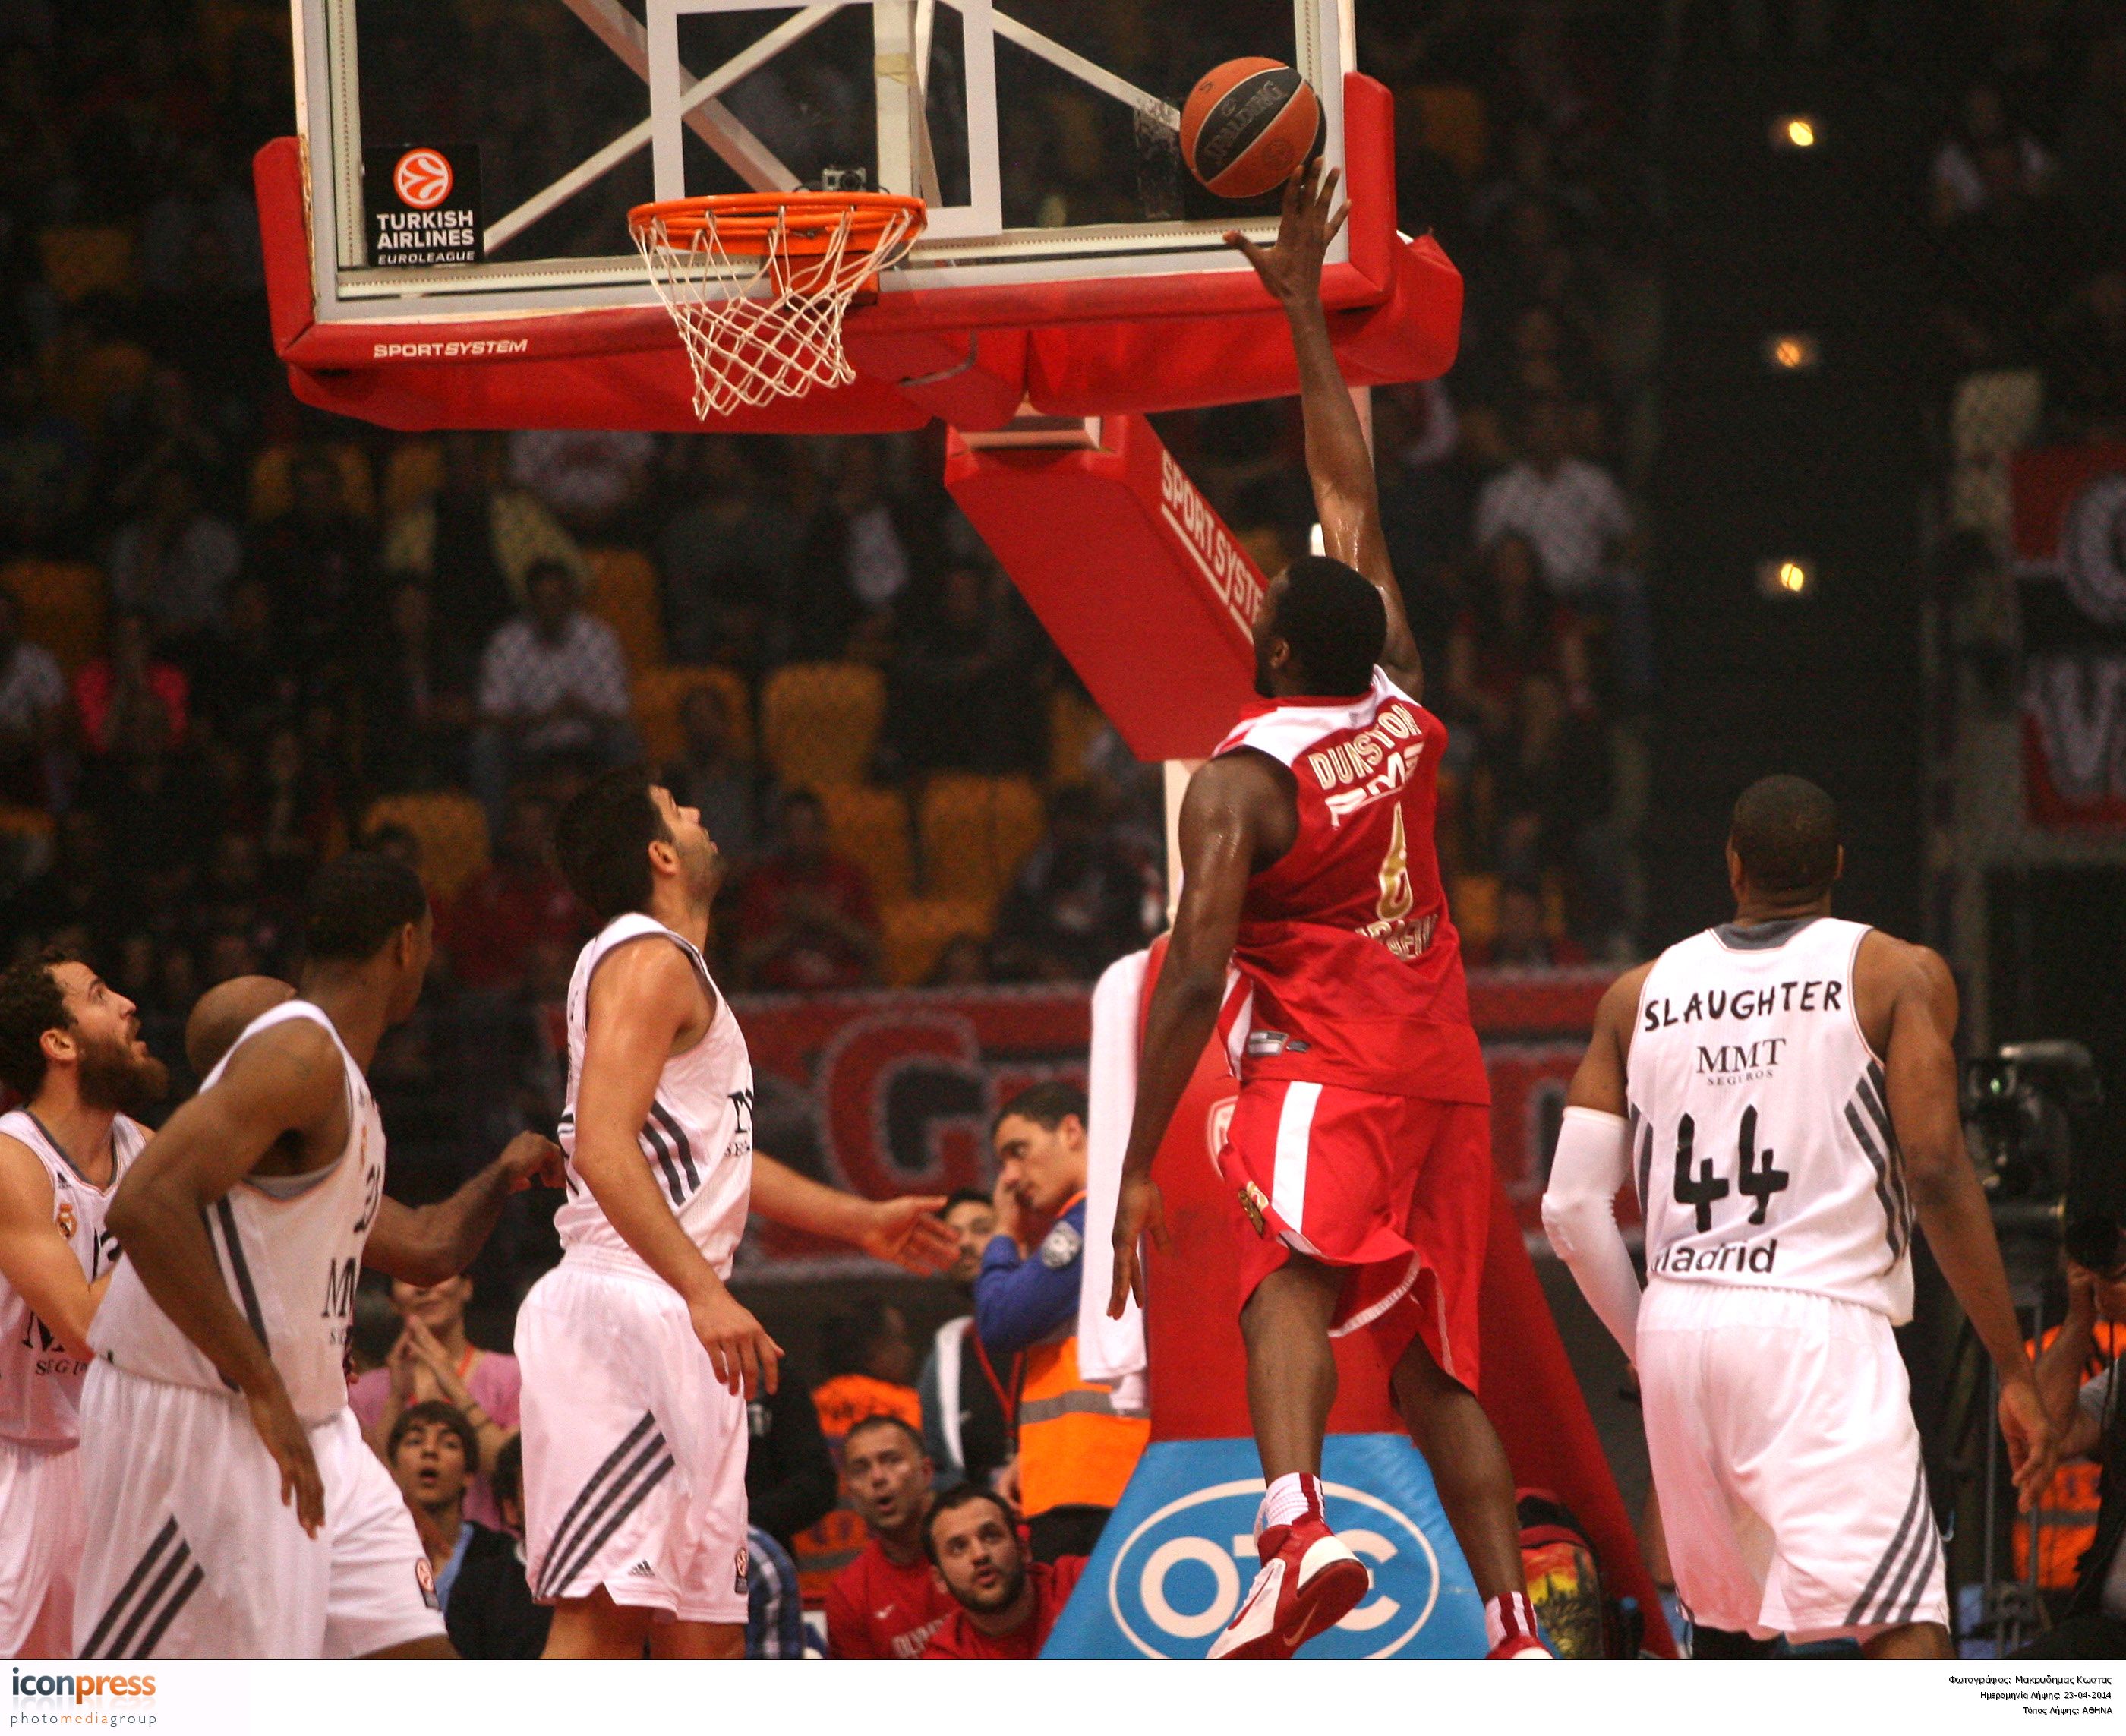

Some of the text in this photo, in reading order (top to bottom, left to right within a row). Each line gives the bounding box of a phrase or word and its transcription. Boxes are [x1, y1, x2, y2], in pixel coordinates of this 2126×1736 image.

[377, 210, 473, 231] TURKISH
[377, 229, 475, 250] AIRLINES
[378, 251, 475, 265] EUROLEAGUE
[1307, 703, 1423, 791] DUNSTON
[1645, 980, 1842, 1031] SLAUGHTER
[1695, 1038, 1787, 1073] MMT
[1707, 1069, 1774, 1087] SEGUROS
[1673, 1105, 1789, 1233] 44
